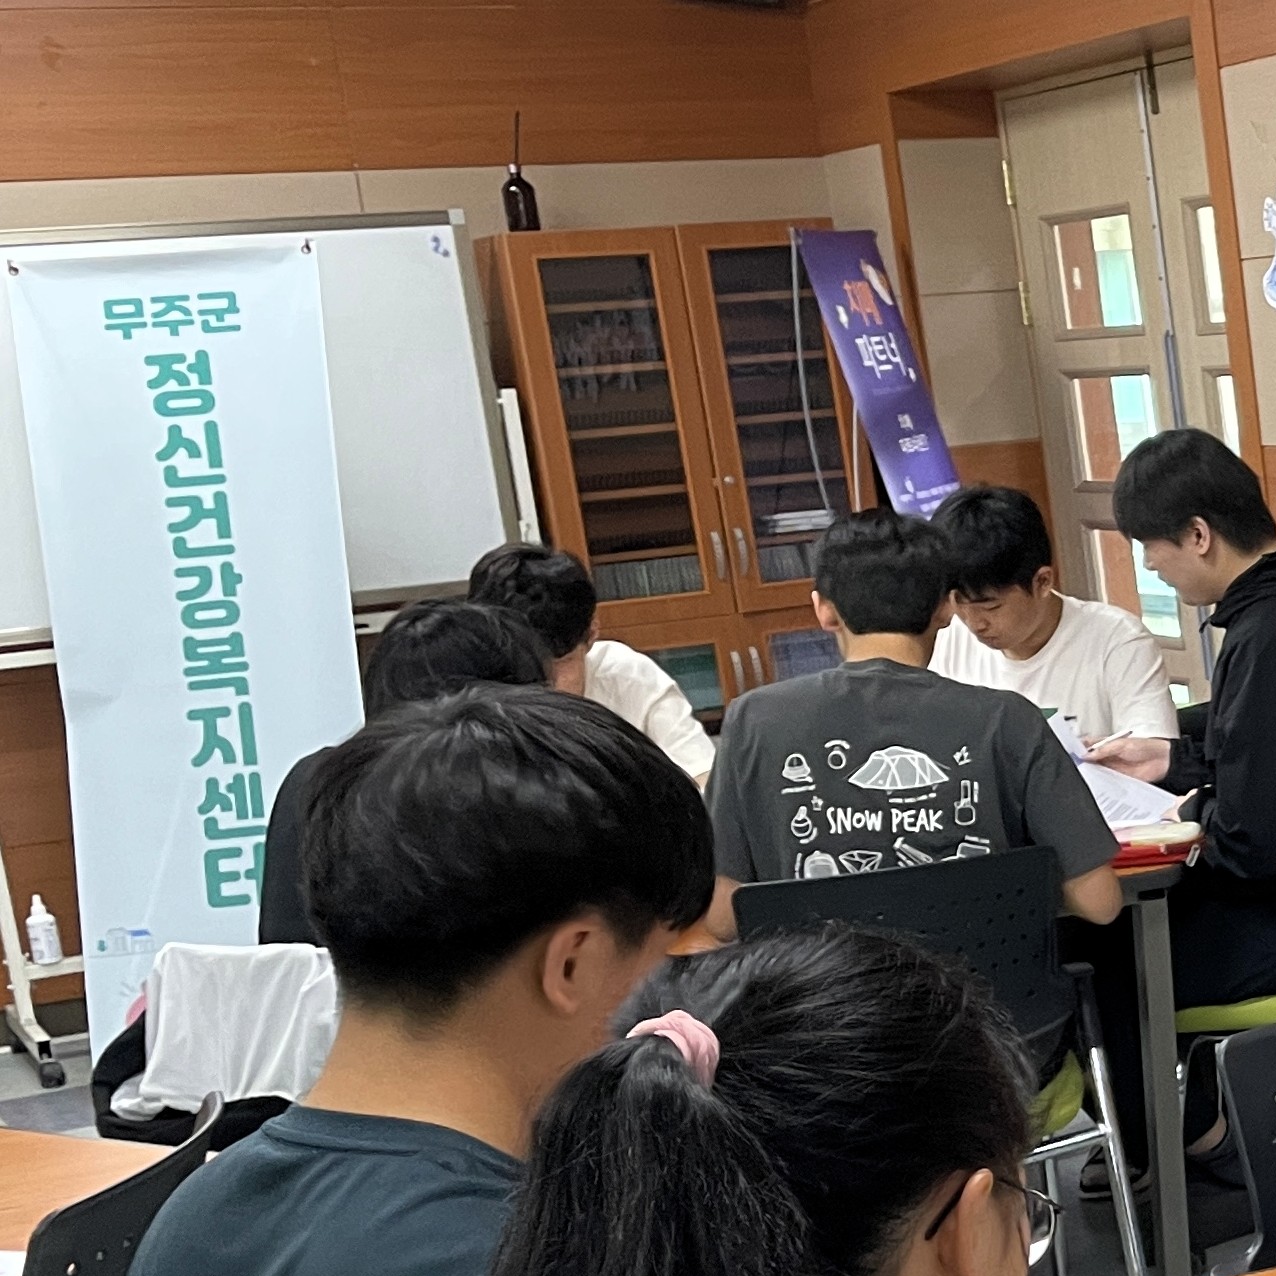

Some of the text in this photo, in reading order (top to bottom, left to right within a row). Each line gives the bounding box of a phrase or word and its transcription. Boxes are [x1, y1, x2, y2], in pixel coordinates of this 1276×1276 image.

[103, 291, 242, 340] 무주군
[144, 349, 267, 908] 정신건강복지센터
[826, 806, 944, 834] SNOW PEAK
